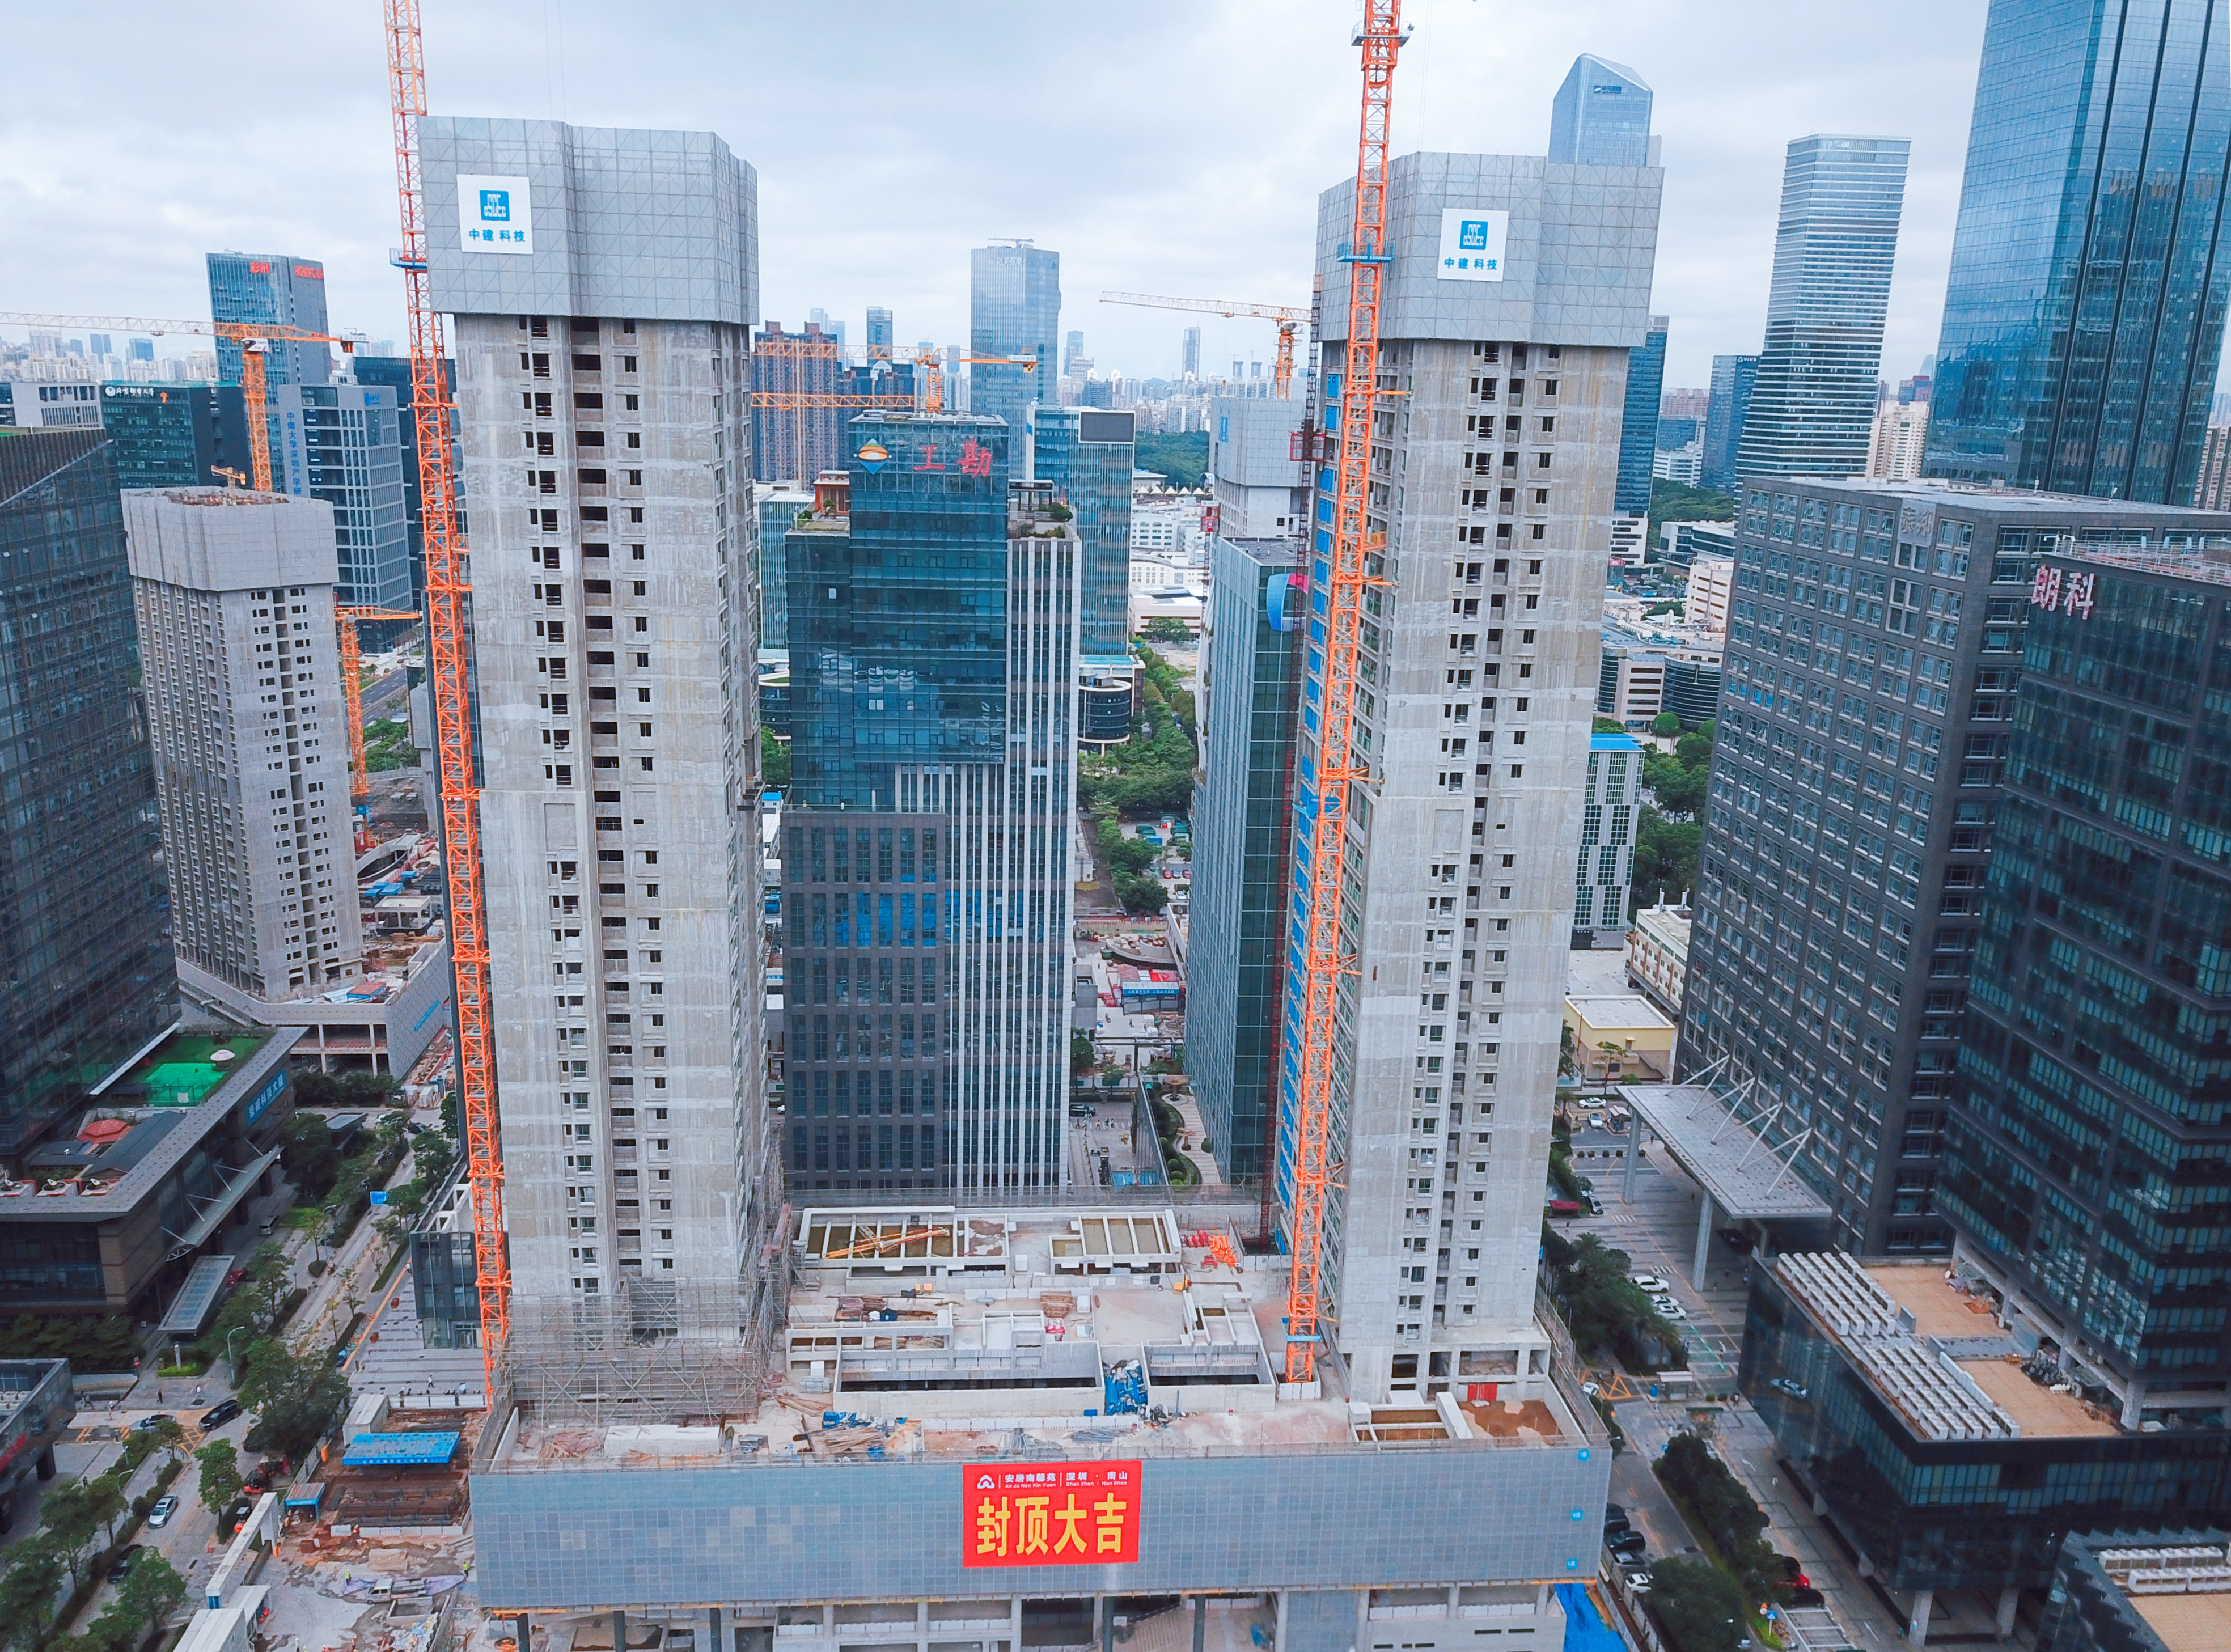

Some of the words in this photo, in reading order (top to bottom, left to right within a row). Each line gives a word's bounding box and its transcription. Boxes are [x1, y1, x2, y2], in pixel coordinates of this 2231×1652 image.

[469, 228, 526, 242] 中建科技
[249, 261, 271, 274] 彩讯
[1444, 257, 1497, 270] 中建科技
[912, 438, 992, 478] 工勘
[2031, 564, 2095, 620] 朗科
[1066, 1472, 1087, 1481] 深圳
[1107, 1471, 1128, 1480] 南山
[977, 1493, 1127, 1557] 封顶大吉
